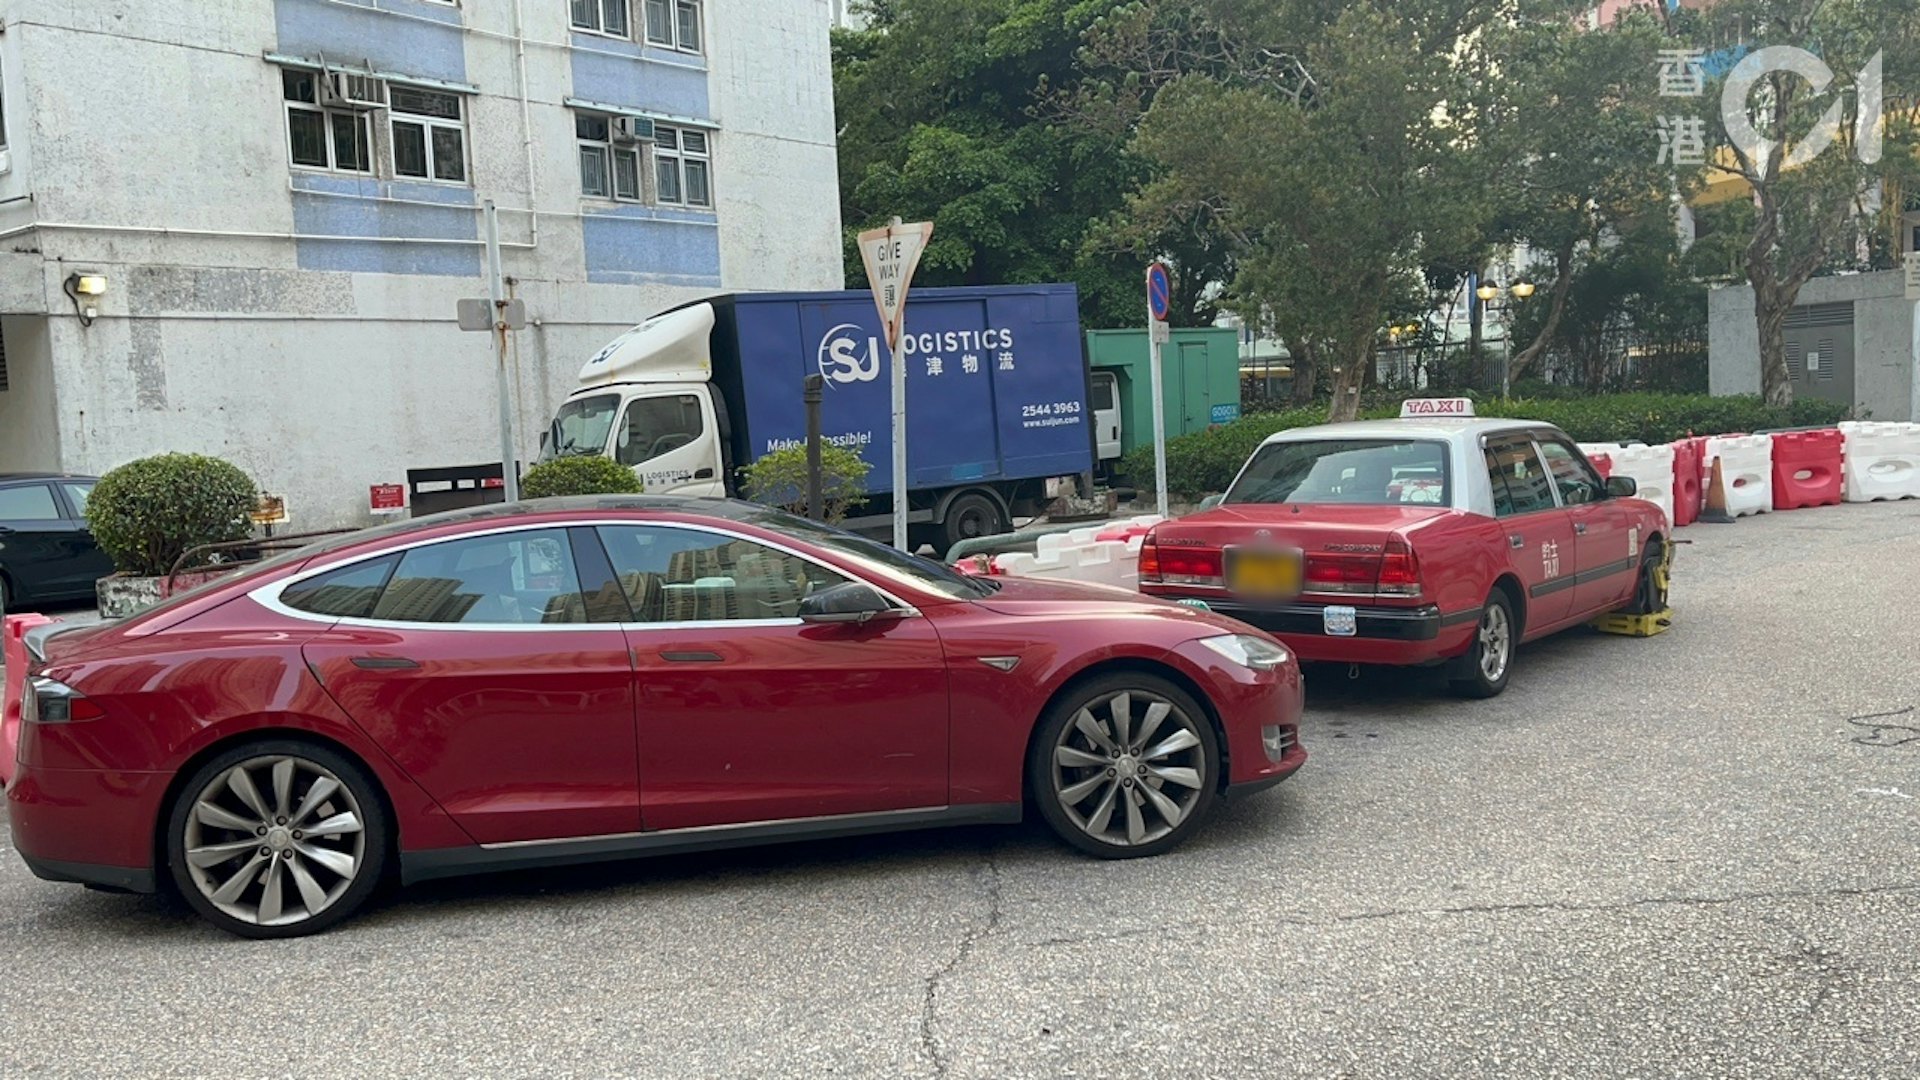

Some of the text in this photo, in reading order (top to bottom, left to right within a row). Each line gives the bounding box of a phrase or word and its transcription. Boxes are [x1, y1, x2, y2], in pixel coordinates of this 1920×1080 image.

[877, 241, 901, 262] GIVE
[879, 262, 901, 280] WAY
[829, 328, 1013, 384] SJ OGISTICS
[902, 351, 1015, 377] 津物流
[1022, 401, 1080, 417] 2544 3963
[1406, 400, 1465, 414] TAXI
[766, 437, 800, 453] Make
[646, 470, 690, 480] LOGISTICS
